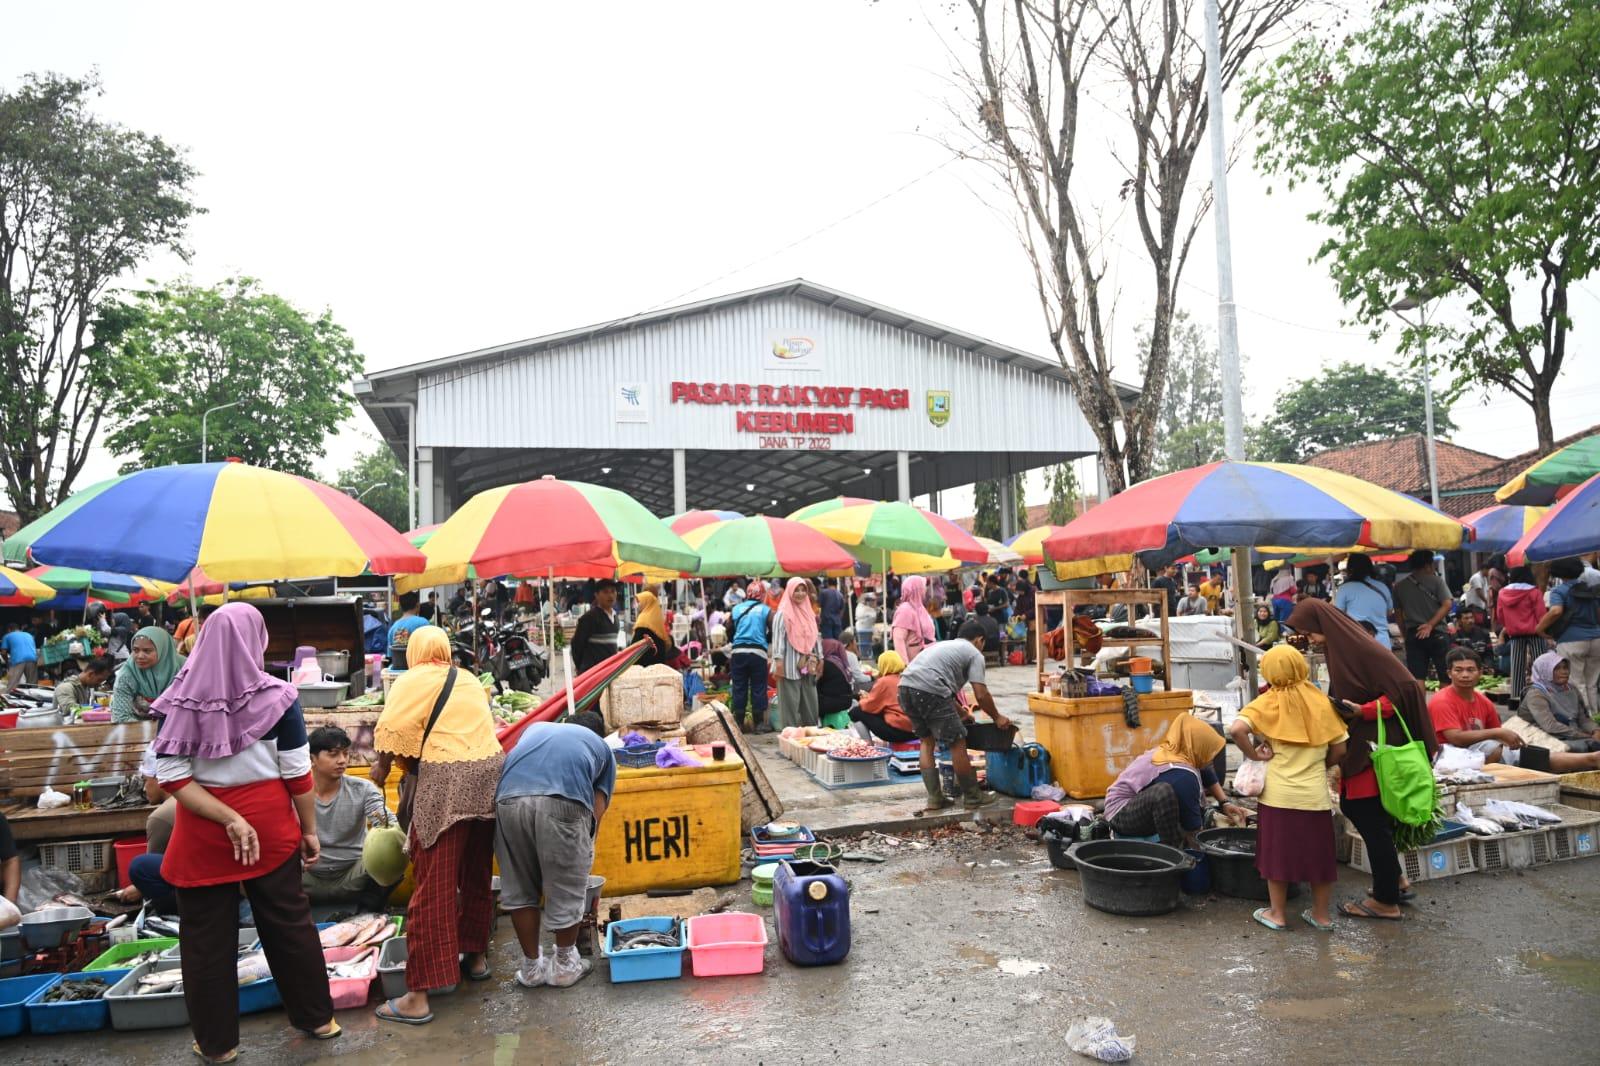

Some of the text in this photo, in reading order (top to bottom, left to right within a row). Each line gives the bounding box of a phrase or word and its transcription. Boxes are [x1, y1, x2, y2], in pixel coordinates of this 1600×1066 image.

[671, 381, 910, 410] PASAR RAKYAT PAGI
[736, 411, 854, 434] KEBUMEN
[759, 436, 831, 450] DANA TP 2023
[624, 814, 690, 864] HERI
